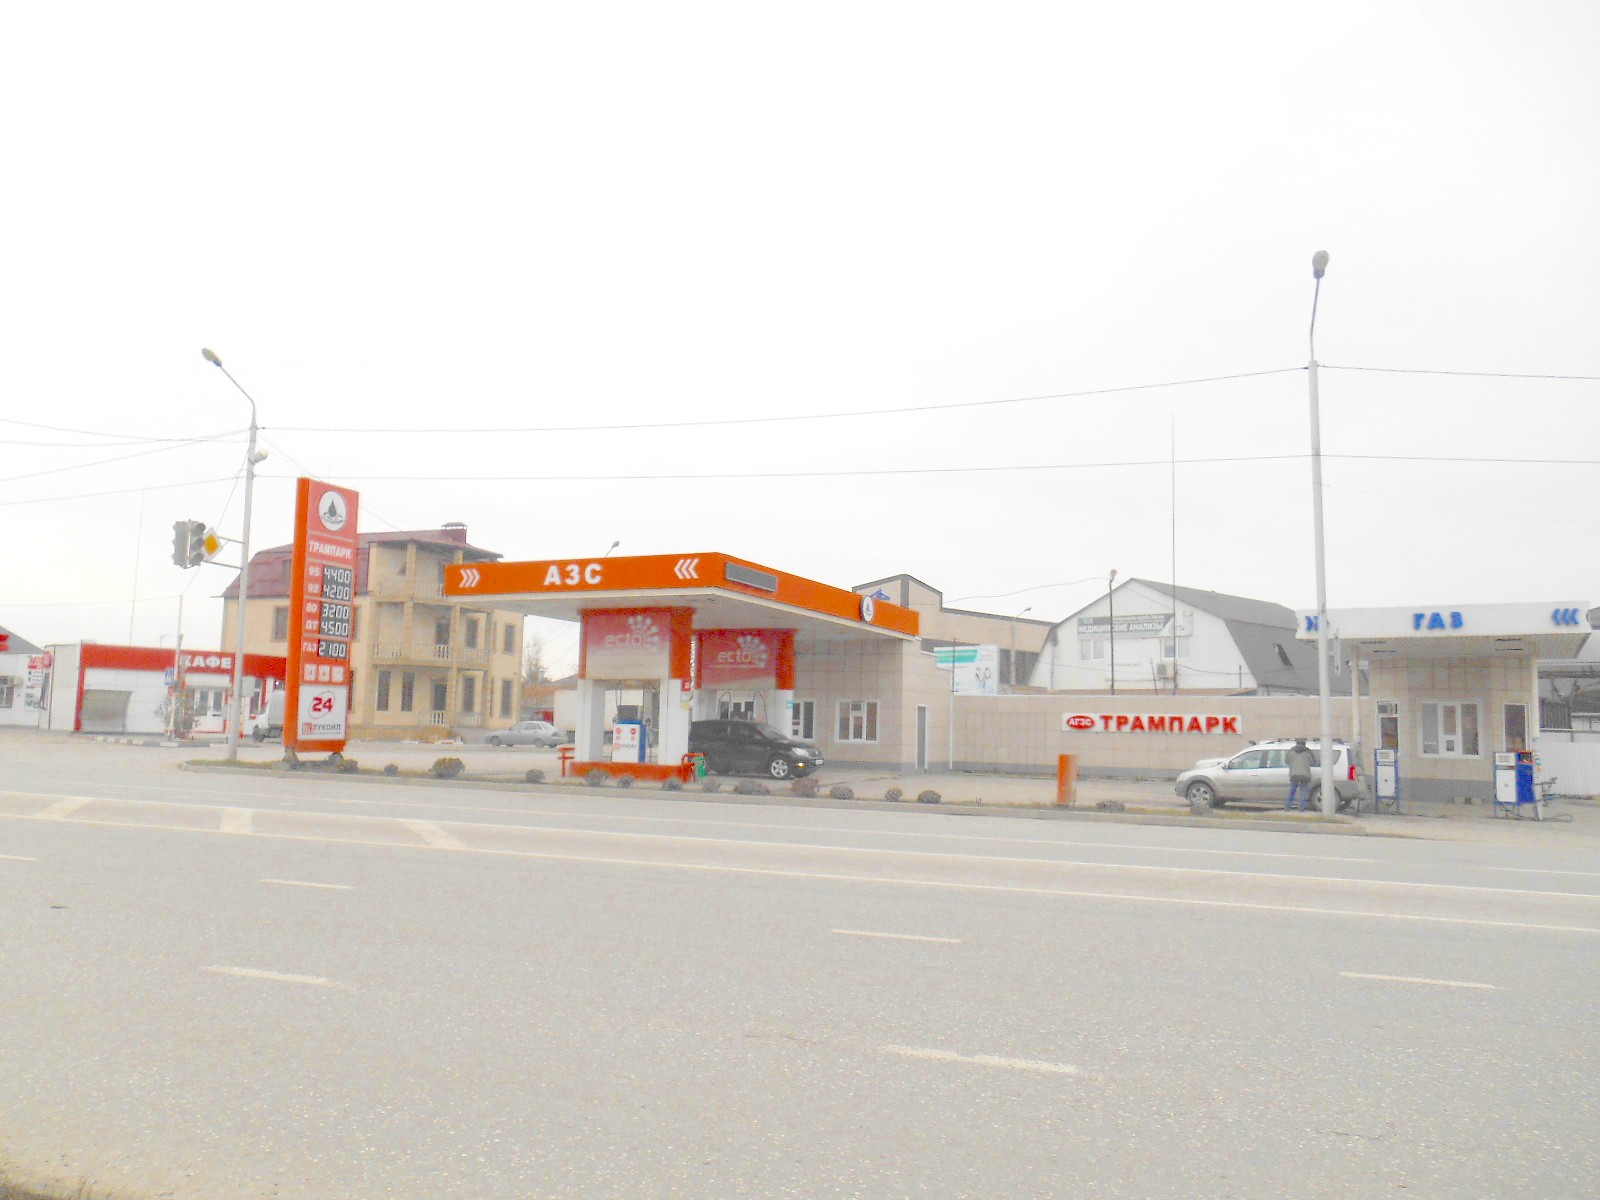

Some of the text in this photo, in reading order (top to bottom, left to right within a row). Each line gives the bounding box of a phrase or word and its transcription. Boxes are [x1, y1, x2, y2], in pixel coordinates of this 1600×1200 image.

[309, 541, 352, 560] ТРАМПАРК
[308, 566, 351, 584] 95 4400
[543, 563, 603, 587] АЗС
[323, 584, 350, 600] 4200
[322, 603, 349, 619] 3200
[320, 620, 349, 637] 4500
[1129, 622, 1164, 631] АНАЛИЗЫ
[1413, 611, 1464, 630] ГАЗ
[604, 630, 642, 647] ecto
[319, 642, 346, 657] 2100
[717, 649, 752, 663] ecto
[183, 655, 233, 670] КАФЕ
[312, 696, 333, 713] 24
[1100, 714, 1238, 734] ТРАМПАРК
